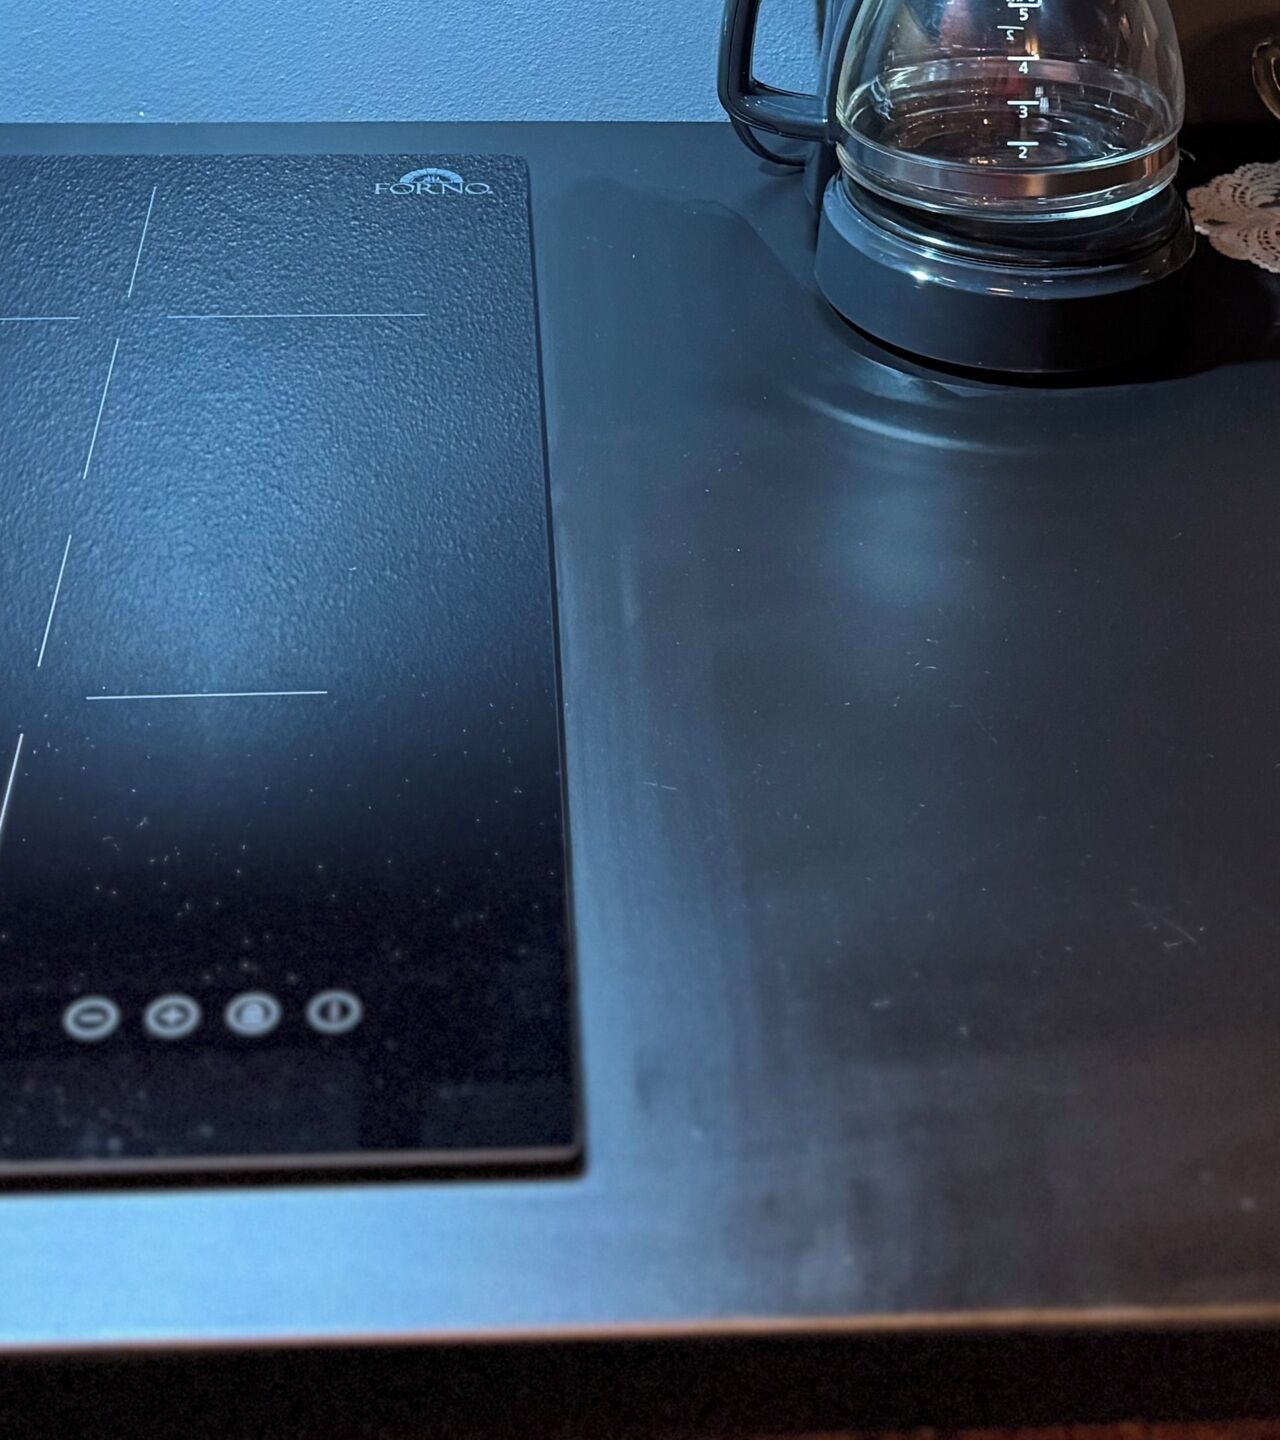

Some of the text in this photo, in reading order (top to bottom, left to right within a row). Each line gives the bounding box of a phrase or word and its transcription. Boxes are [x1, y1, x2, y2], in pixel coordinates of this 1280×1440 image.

[1019, 8, 1029, 21] 5
[1019, 61, 1029, 74] 4
[1019, 105, 1028, 118] 3
[1018, 146, 1028, 159] 2
